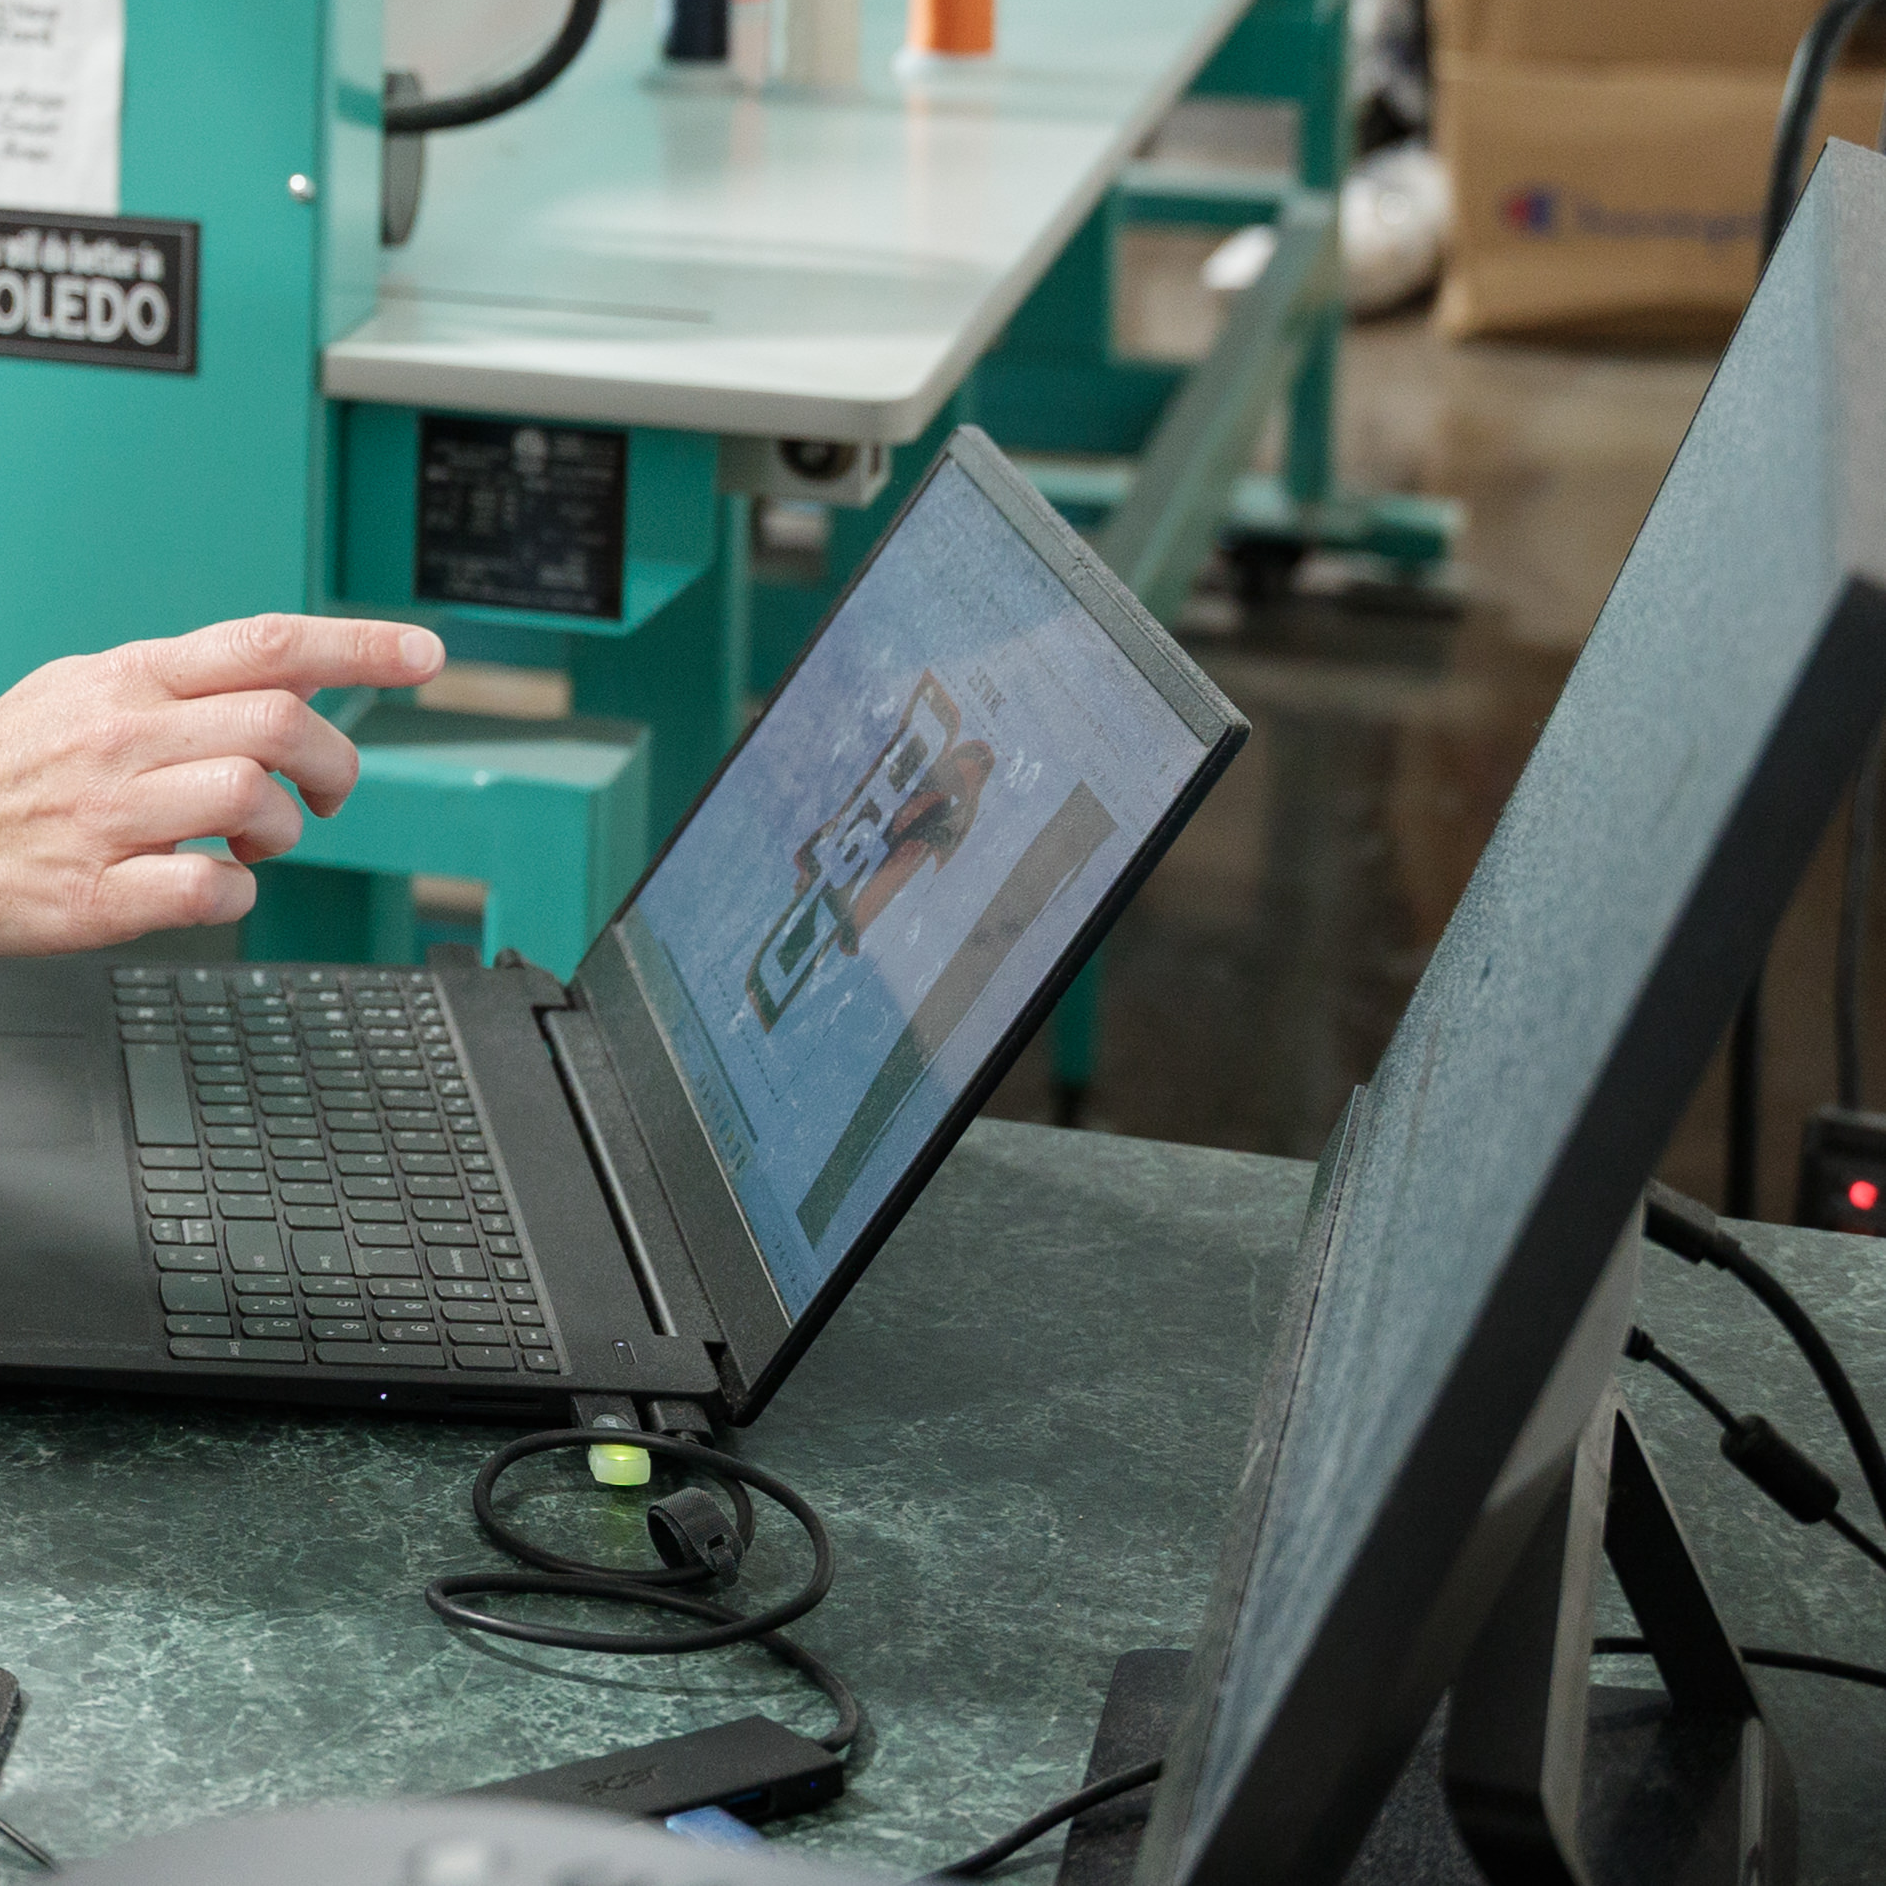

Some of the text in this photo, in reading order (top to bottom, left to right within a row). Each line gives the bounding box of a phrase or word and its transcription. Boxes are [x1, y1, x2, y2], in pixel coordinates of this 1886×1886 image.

[3, 227, 41, 271] will
[69, 230, 139, 279] better
[228, 1341, 240, 1356] Enter
